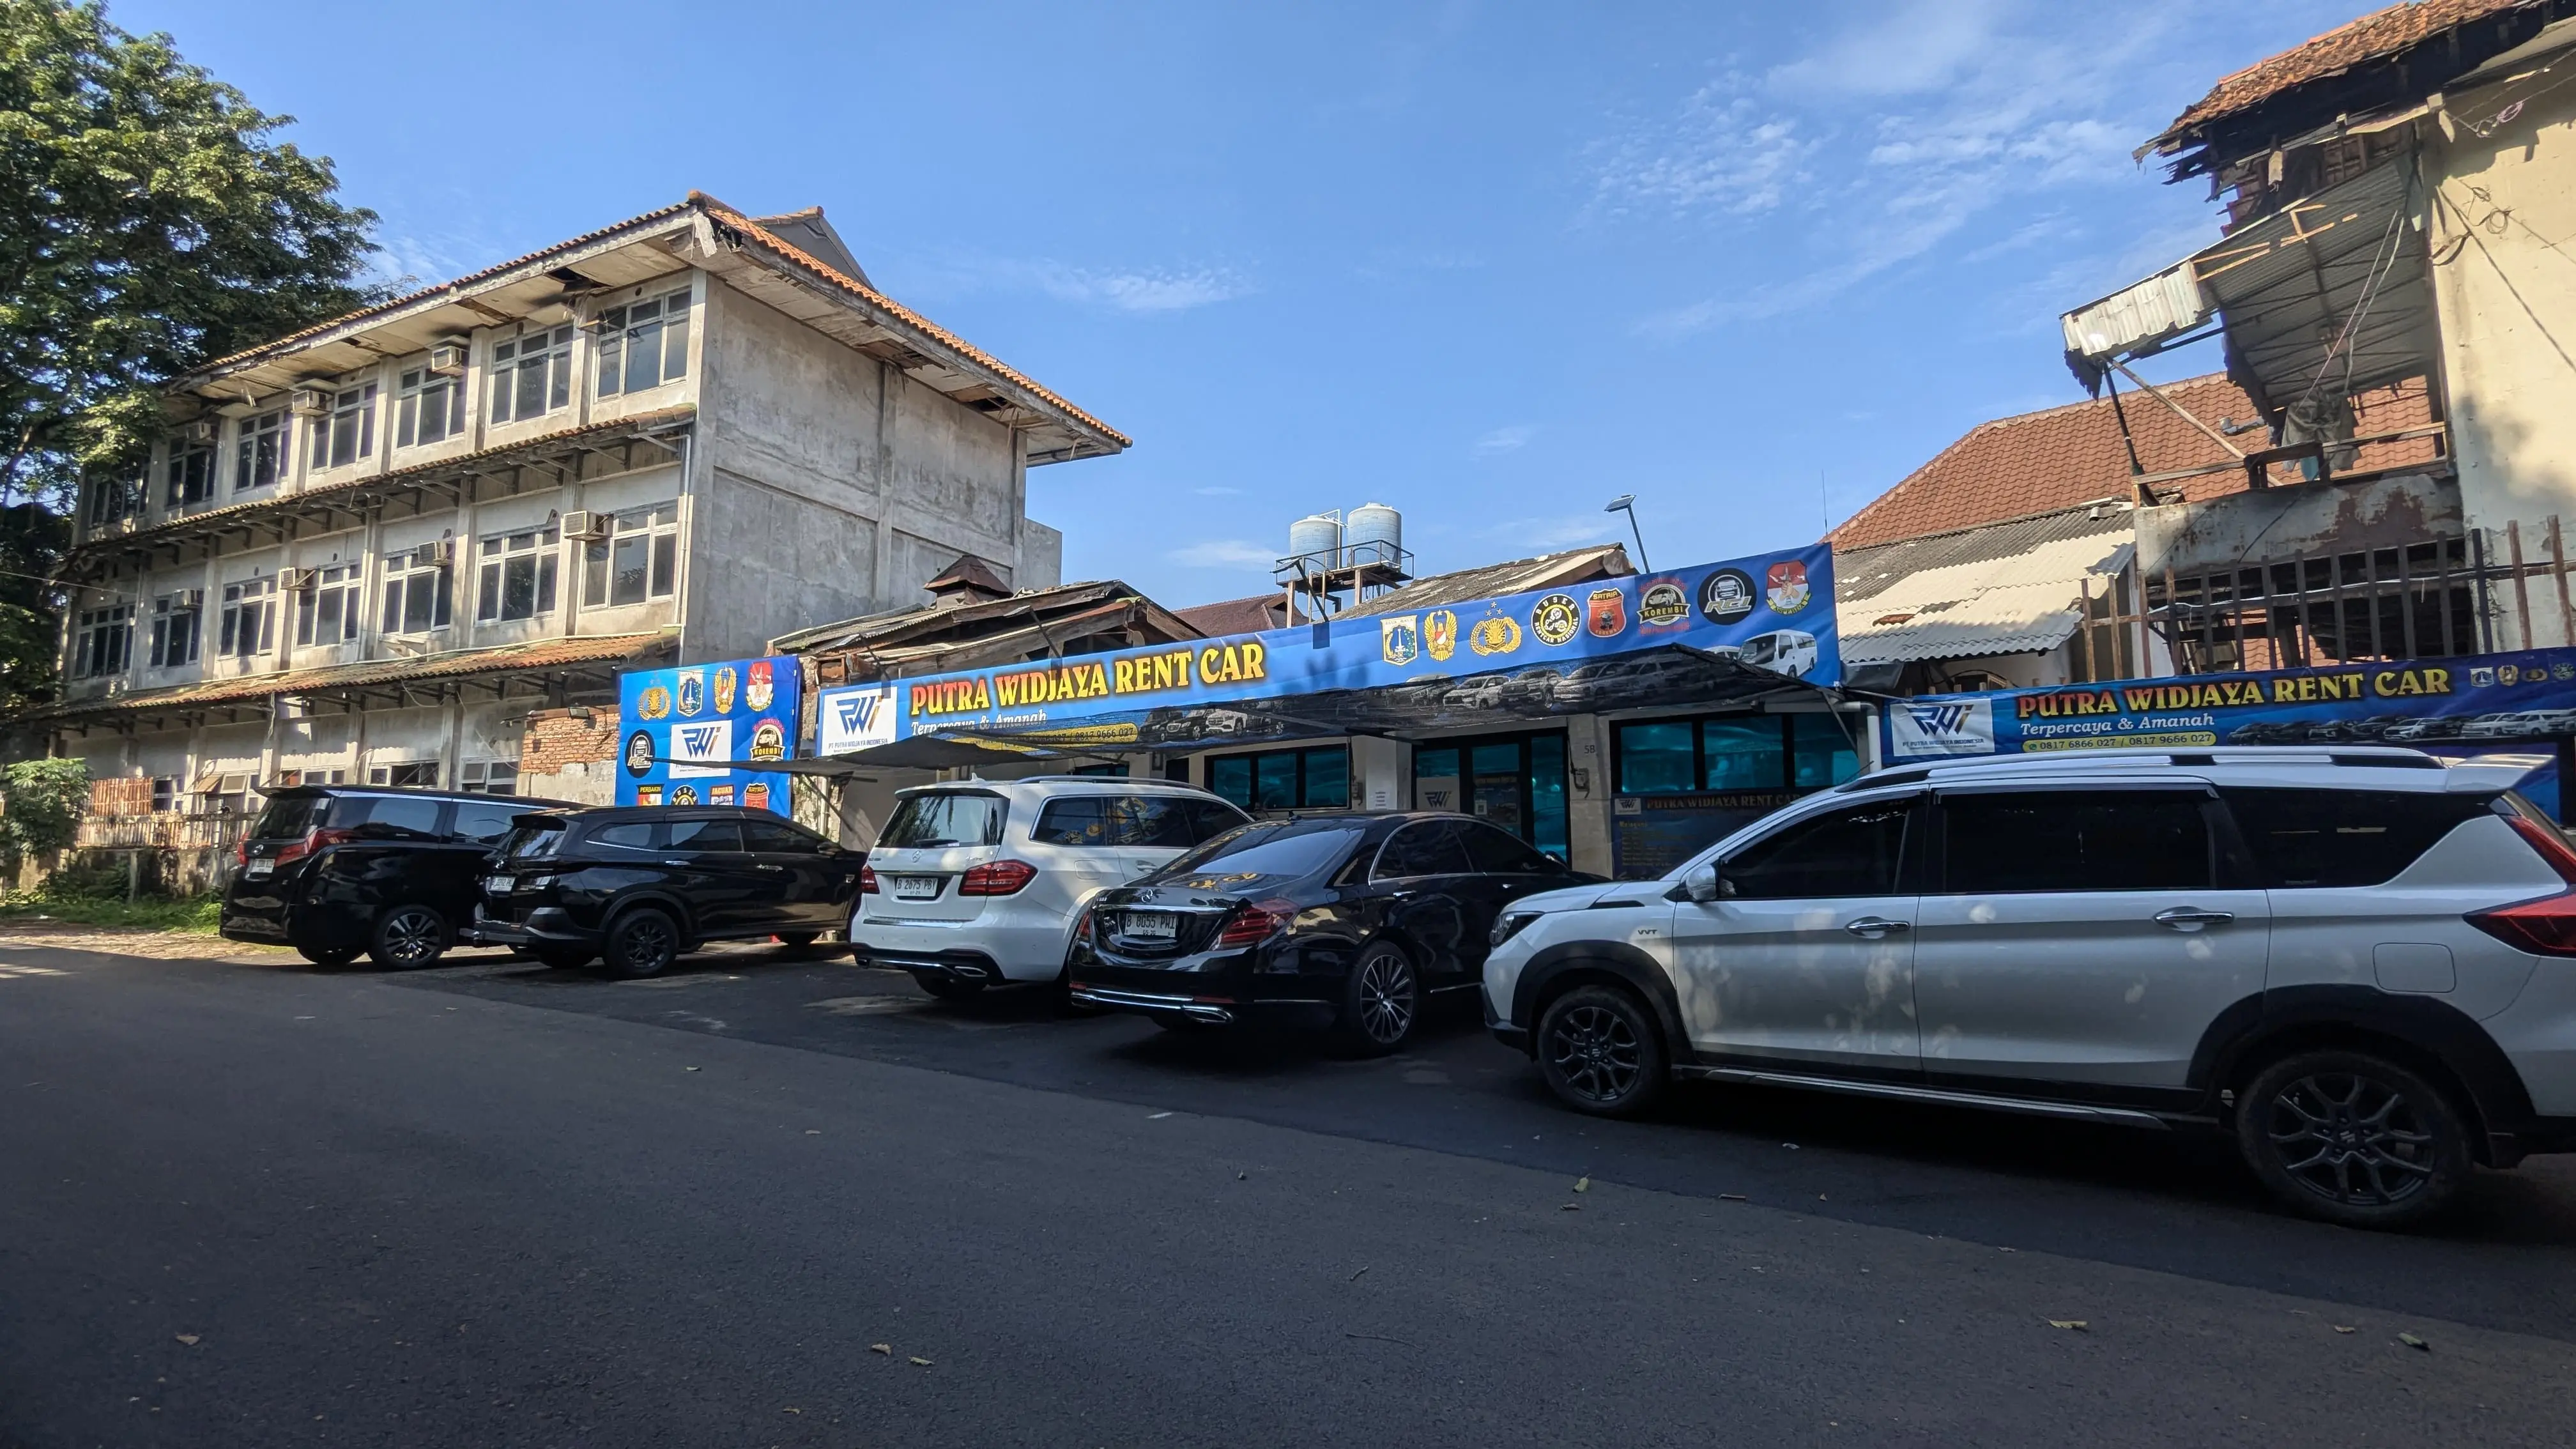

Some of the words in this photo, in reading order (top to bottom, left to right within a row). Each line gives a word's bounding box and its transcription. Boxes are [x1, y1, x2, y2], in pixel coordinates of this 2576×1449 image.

[1593, 590, 1618, 600] SATRIA
[1535, 597, 1576, 615] BUSER
[1644, 606, 1683, 617] KOREMBI
[1557, 617, 1579, 643] NASIONAL
[911, 679, 990, 715] PUTRA
[994, 664, 1108, 707] WIDJAYA
[1115, 650, 1192, 693] RENT
[1200, 643, 1265, 684] CAR
[2018, 691, 2118, 718] PUTRA
[2124, 681, 2264, 710] WIDJAYA
[2273, 673, 2364, 703] RENT
[2374, 669, 2451, 697] CAR
[979, 715, 990, 730] &
[993, 708, 1047, 729] Amanah
[2020, 720, 2112, 737] Terpercaya
[2118, 717, 2134, 730] &
[2138, 712, 2214, 729] Amanah
[1096, 728, 1116, 739] 9666
[1119, 727, 1134, 737] 027
[2040, 740, 2065, 749] 0817
[2069, 739, 2093, 748] 6866
[2097, 739, 2117, 747] 027
[2129, 737, 2156, 746] 0817
[2159, 735, 2188, 744] 9666
[2191, 734, 2212, 742] 027
[711, 786, 733, 795] JAGUAR
[1646, 799, 1684, 809] PUTRA
[1741, 795, 1773, 807] RENT
[897, 879, 902, 889] B
[904, 879, 921, 889] 2675
[924, 878, 936, 889] PBY
[1126, 915, 1132, 927] B
